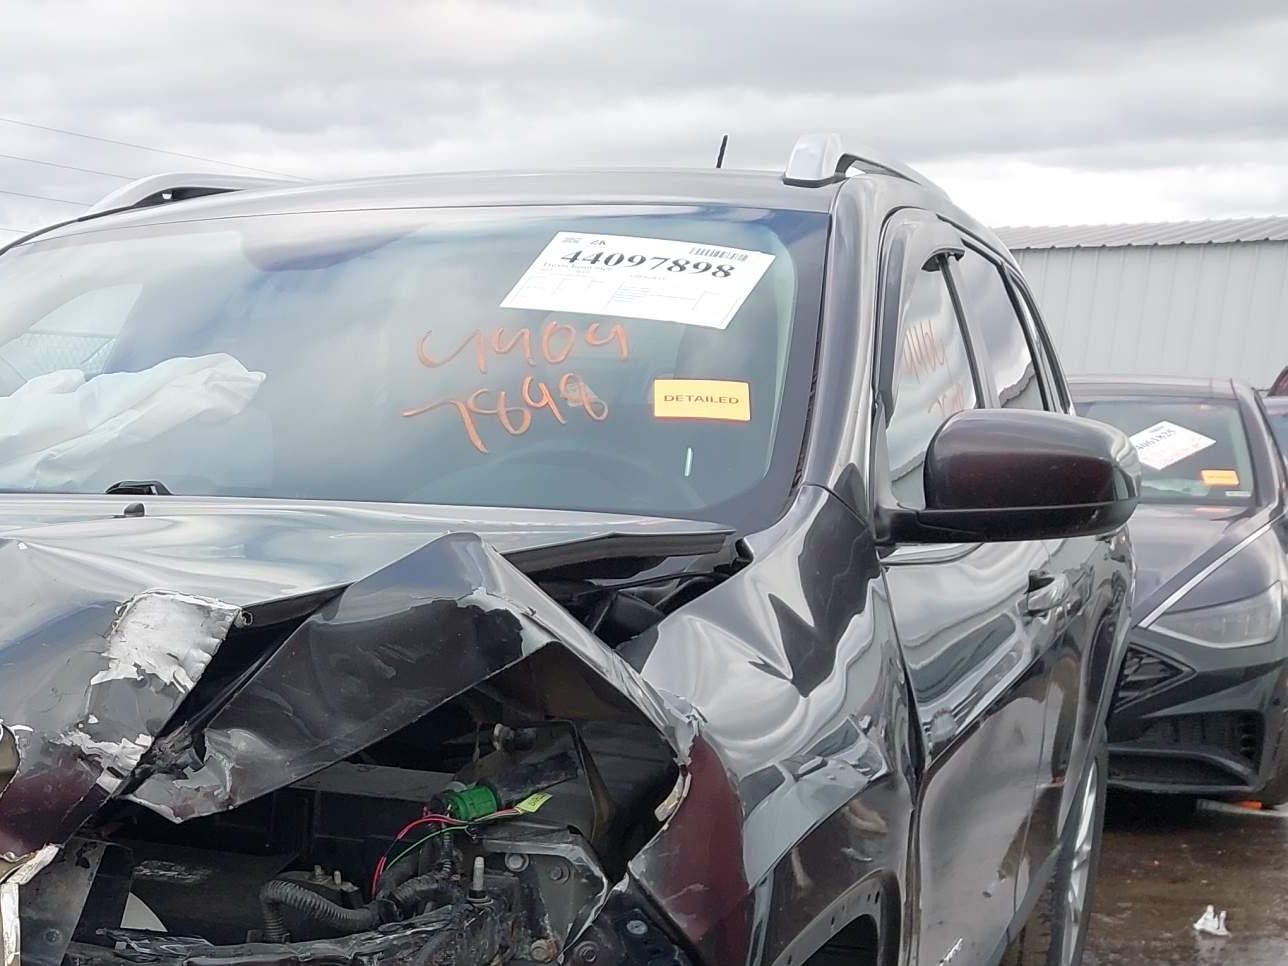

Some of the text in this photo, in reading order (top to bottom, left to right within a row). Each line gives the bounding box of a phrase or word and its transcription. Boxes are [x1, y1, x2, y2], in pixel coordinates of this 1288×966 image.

[560, 250, 736, 278] 44097898
[401, 373, 609, 454] 7898
[663, 394, 739, 405] DETAILED
